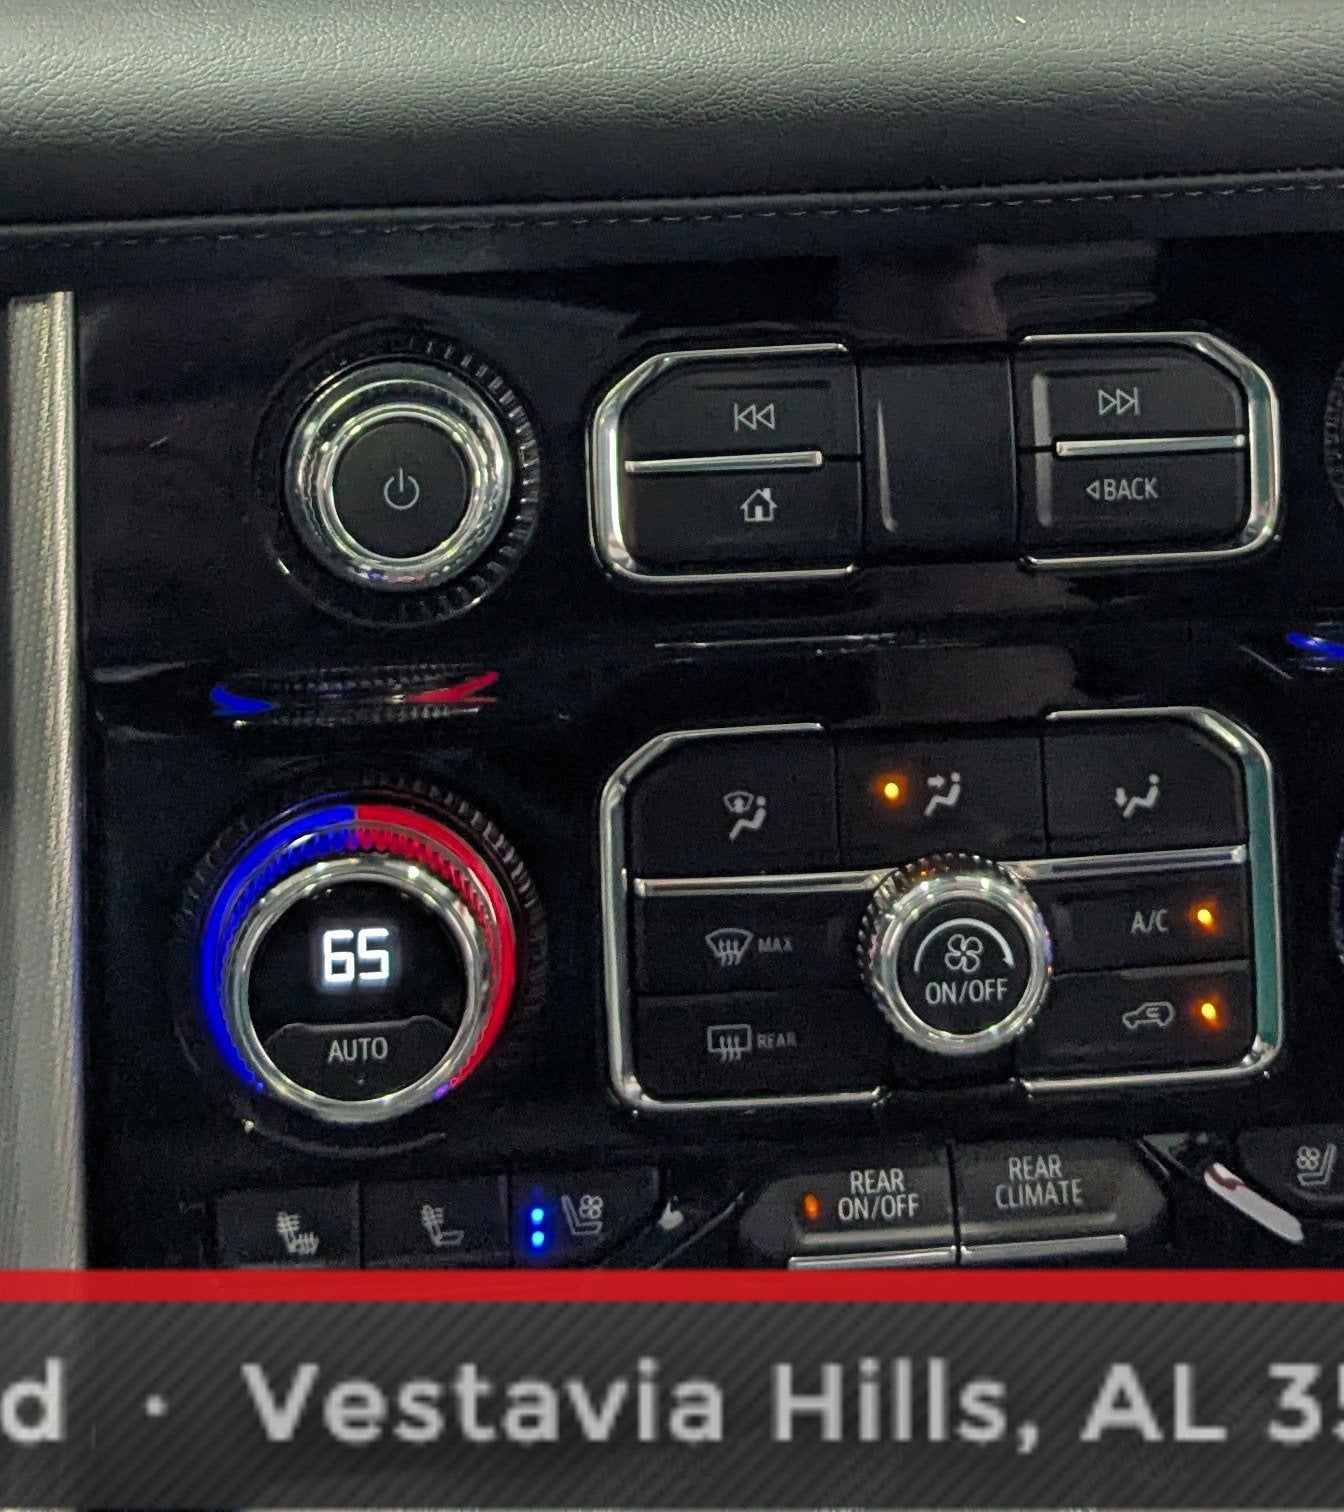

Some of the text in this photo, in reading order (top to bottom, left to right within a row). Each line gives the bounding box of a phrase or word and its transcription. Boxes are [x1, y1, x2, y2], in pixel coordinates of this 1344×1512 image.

[1103, 477, 1159, 502] BACK
[1130, 909, 1168, 934] A/C
[321, 927, 390, 984] 65
[758, 937, 793, 954] MAX
[925, 979, 1009, 1006] ON/OFF
[327, 1037, 389, 1063] AUTO
[756, 1031, 797, 1049] REAR
[1008, 1154, 1063, 1179] REAR
[849, 1168, 905, 1192] REAR
[995, 1178, 1083, 1208] CLIMATE
[838, 1193, 920, 1222] ON/OFF
